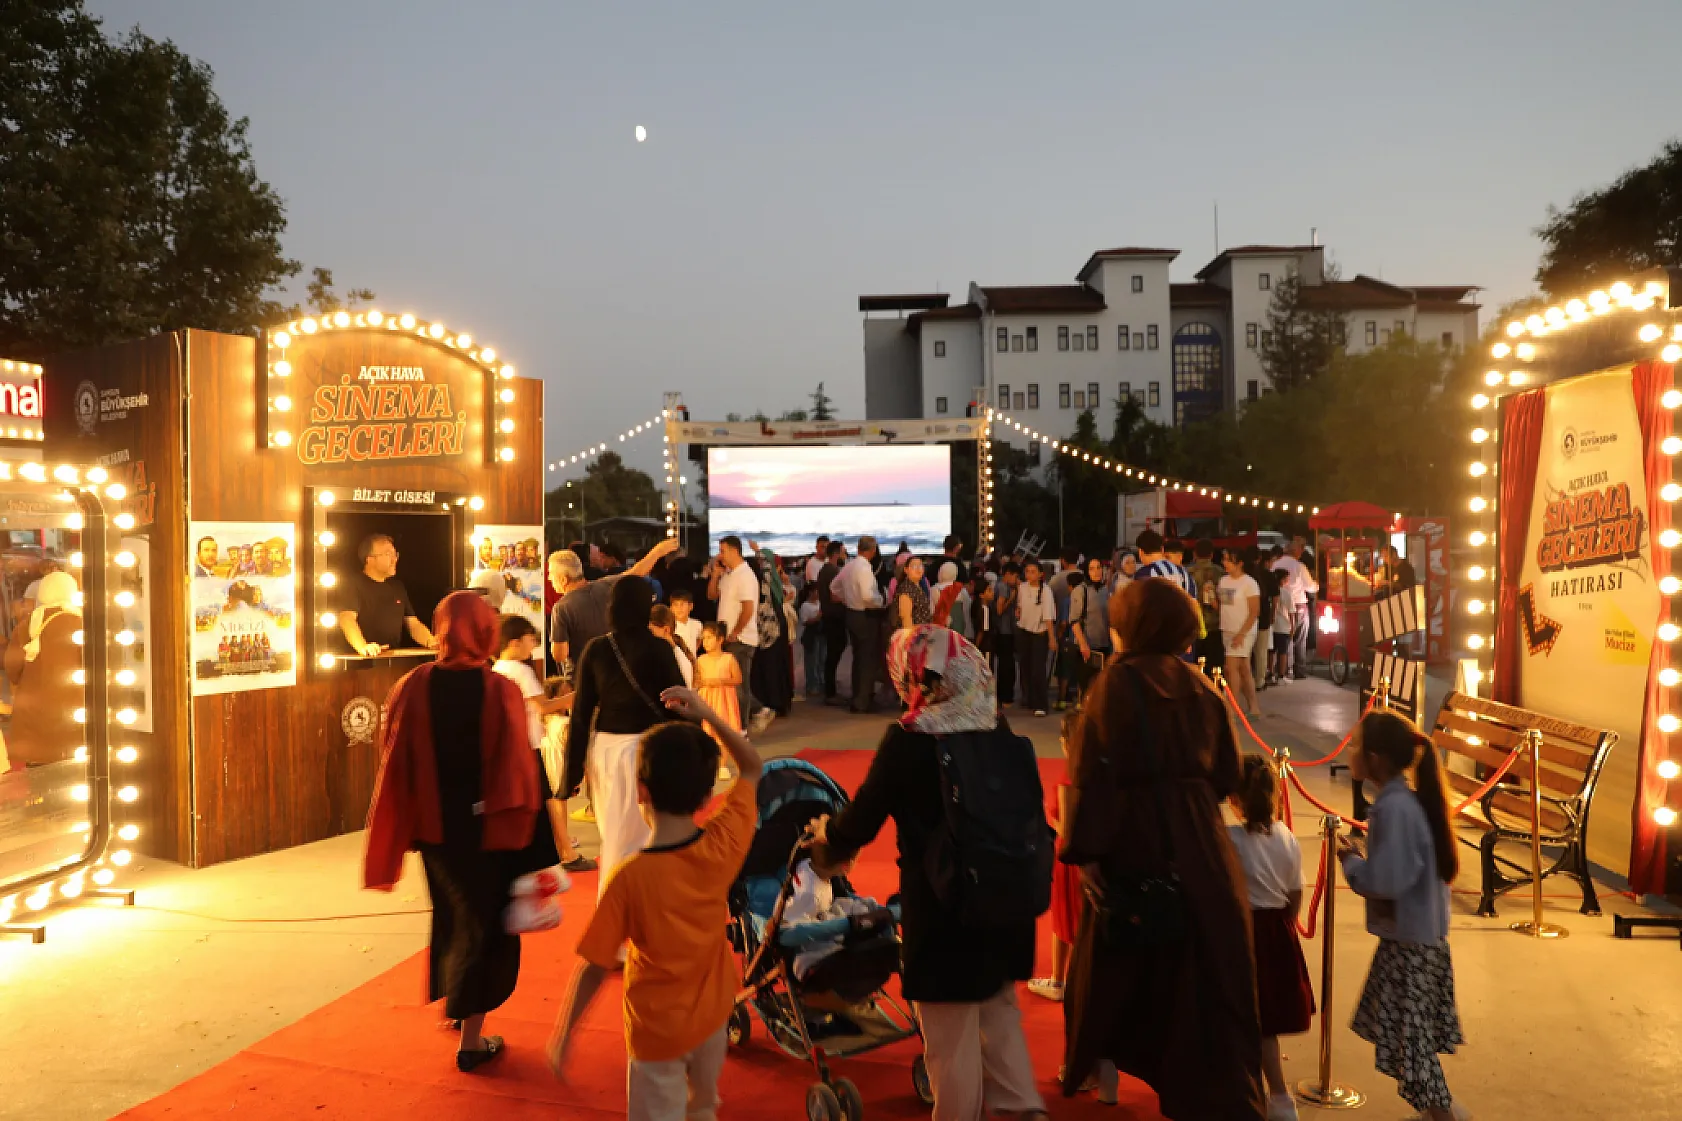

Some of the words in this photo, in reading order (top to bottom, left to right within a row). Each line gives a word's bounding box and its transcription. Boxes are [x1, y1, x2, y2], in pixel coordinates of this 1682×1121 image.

[312, 374, 453, 423] SİNEMA
[358, 366, 390, 384] AÇIK
[391, 366, 425, 381] HAVA
[297, 410, 467, 465] GECELERİ
[352, 487, 392, 503] BİLET
[1543, 481, 1630, 535] SİNEMA
[1537, 505, 1641, 571] GECELERİ
[1551, 571, 1623, 598] HATIRASI
